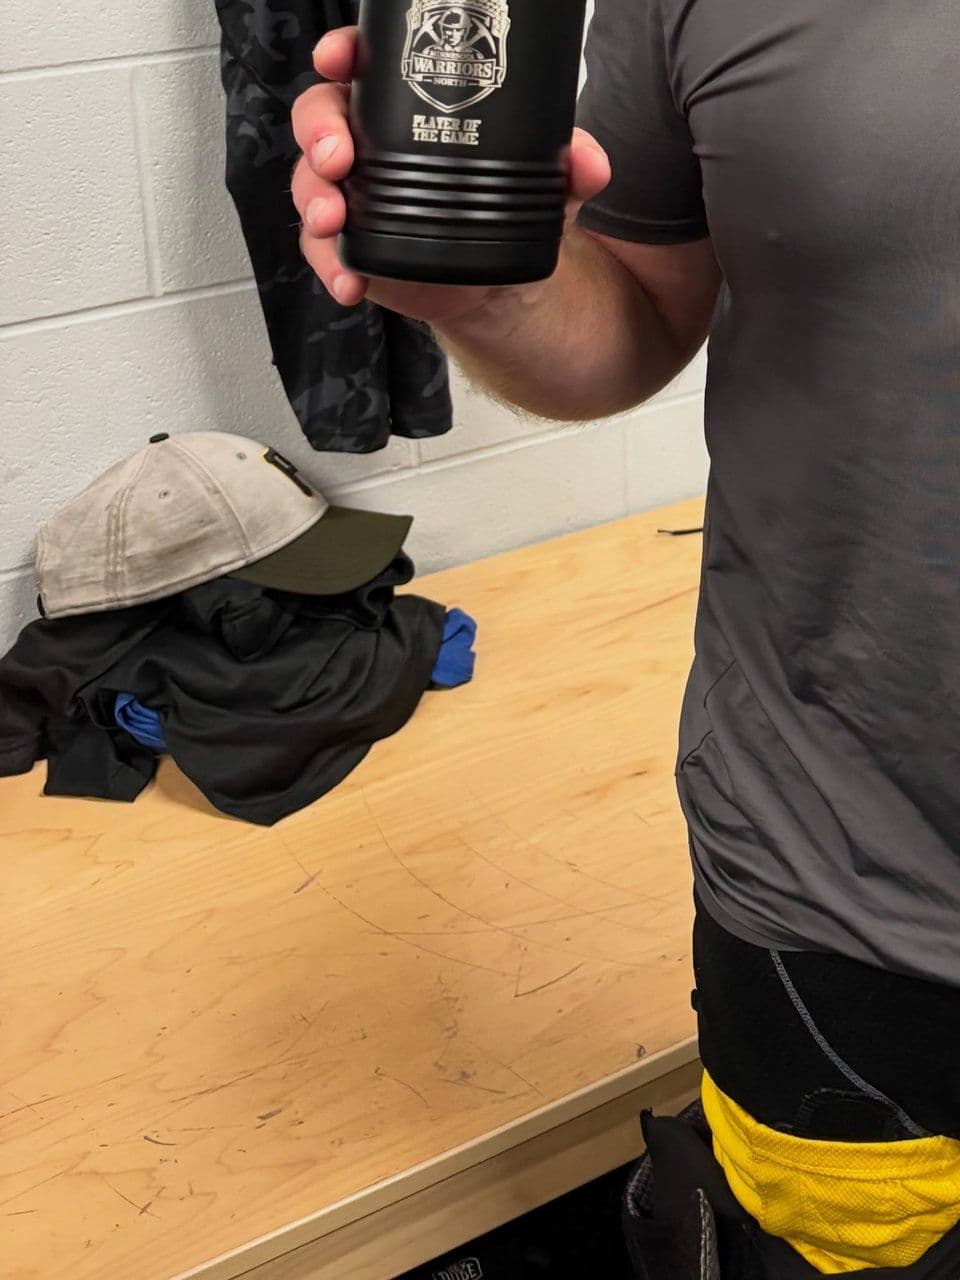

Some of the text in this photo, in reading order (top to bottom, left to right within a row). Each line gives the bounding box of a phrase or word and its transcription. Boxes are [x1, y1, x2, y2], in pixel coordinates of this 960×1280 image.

[413, 56, 492, 78] WARRIORS
[433, 77, 467, 87] NORTH
[413, 115, 482, 132] PLAYER OF
[413, 128, 479, 145] THE GAME
